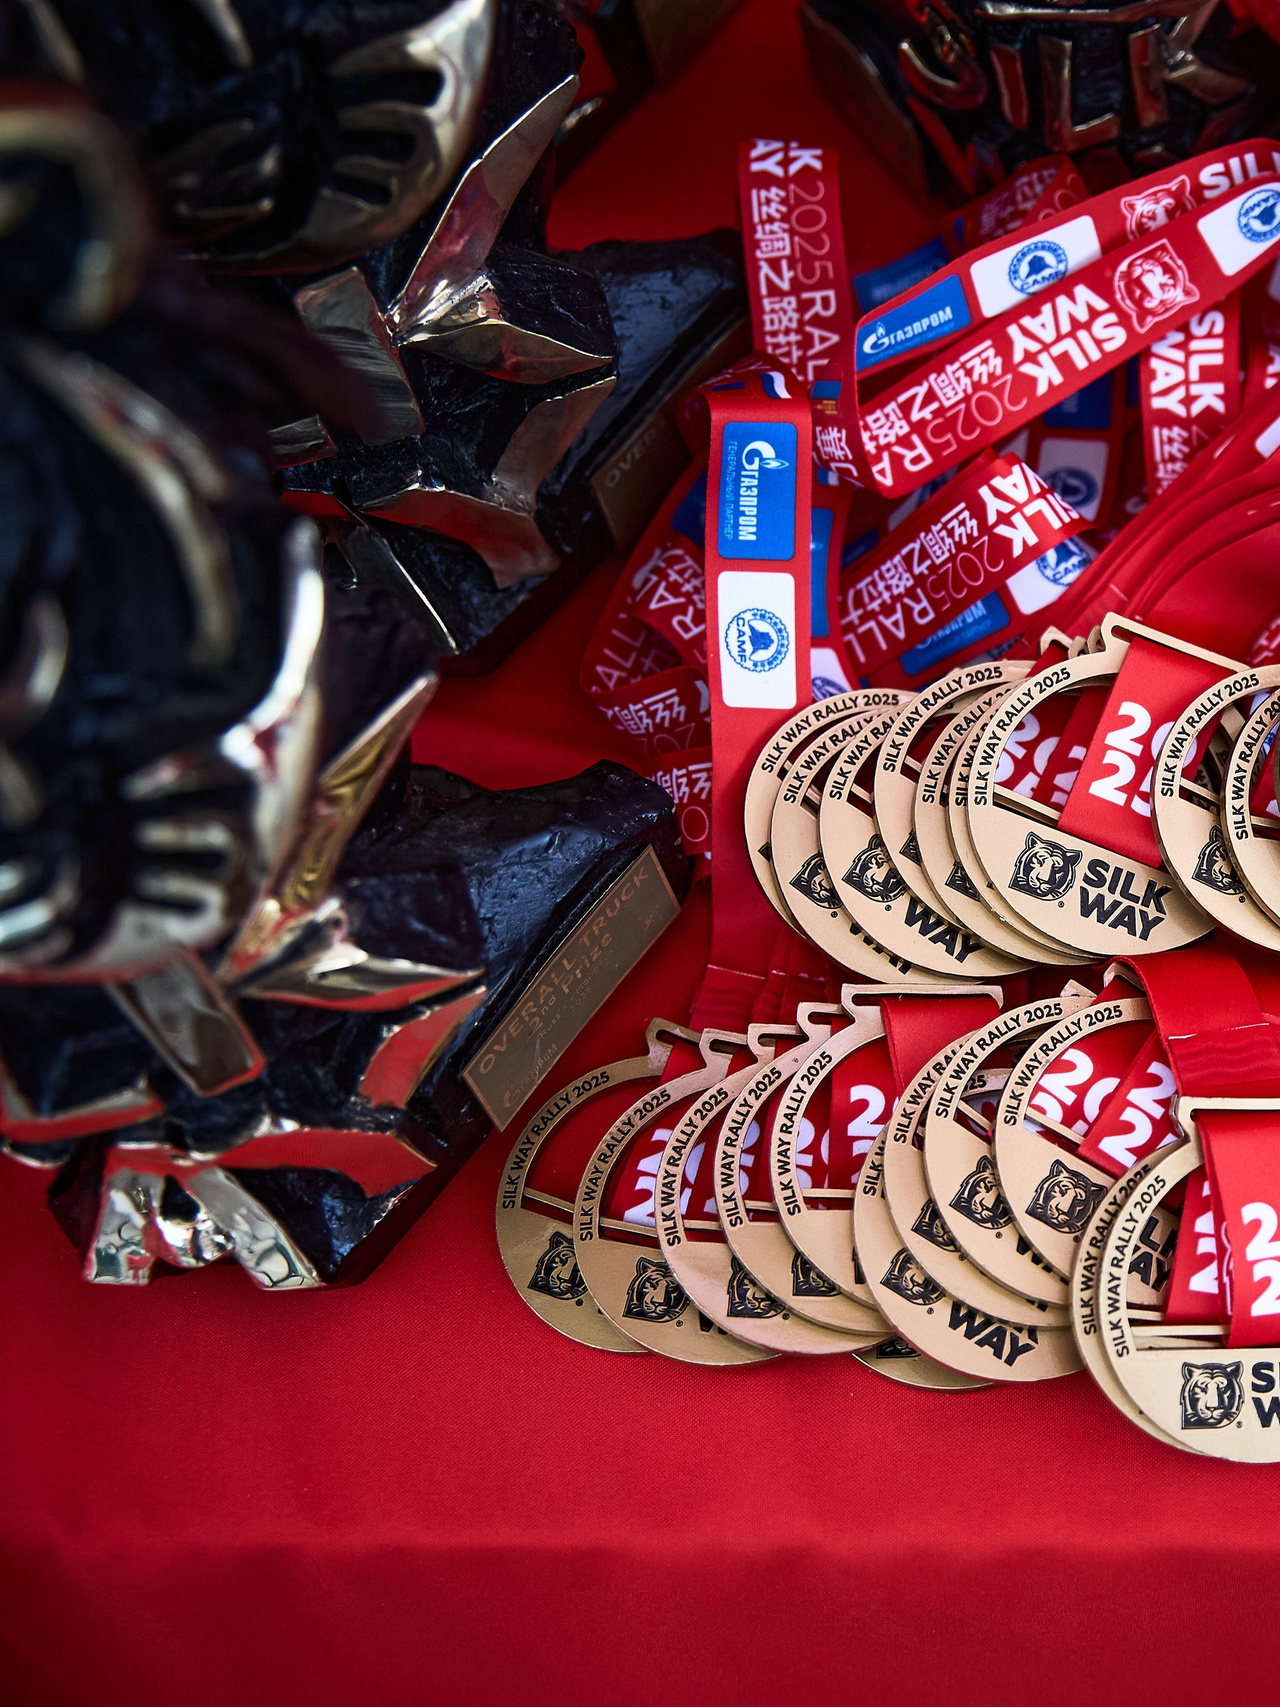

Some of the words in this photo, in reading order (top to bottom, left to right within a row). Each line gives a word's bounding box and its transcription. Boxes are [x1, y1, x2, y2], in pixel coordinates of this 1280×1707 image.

[788, 180, 834, 285] 2025
[889, 305, 952, 347] ГАЗПРОМ
[1007, 284, 1110, 366] WAY
[1019, 312, 1127, 397] SILK
[1150, 332, 1188, 418] WAY
[1189, 310, 1225, 416] SILK
[926, 374, 1027, 457] 2025
[738, 469, 758, 541] ГАЗПРОМ
[993, 492, 1081, 558] SILK
[927, 535, 1005, 613] 2025
[736, 616, 747, 664] CAMF
[920, 676, 964, 712] RALLY
[964, 666, 1003, 686] 2025
[1185, 690, 1224, 728] RALLY
[1223, 673, 1261, 699] 2025
[785, 718, 812, 745] WAY
[813, 698, 859, 723] RALLY
[863, 693, 900, 706] 2025
[980, 731, 1001, 768] WAY
[998, 685, 1036, 732] RALLY
[1033, 667, 1072, 693] 2025
[1104, 701, 1197, 772] 20
[1239, 716, 1266, 764] RALLY
[800, 744, 830, 772] WAY
[1167, 727, 1190, 764] WAY
[1160, 764, 1177, 798] SILK
[1230, 763, 1249, 803] WAY
[1235, 803, 1249, 841] SILK
[1082, 858, 1173, 915] SILK
[1079, 886, 1166, 942] WAY
[478, 955, 578, 1076] OVERALL
[577, 865, 651, 949] TRUCK
[747, 1065, 783, 1104] 2025
[801, 1050, 834, 1089] 2025
[935, 1083, 959, 1119] SILK
[949, 1046, 980, 1084] WAY
[975, 1014, 1022, 1051] RALLY
[1023, 1002, 1064, 1024] 2025
[1003, 1087, 1025, 1127] SILK
[1016, 1051, 1043, 1088] WAY
[1039, 1017, 1083, 1057] RALLY
[1084, 1004, 1124, 1027] 2025
[511, 1134, 536, 1175] WAY
[533, 1092, 572, 1137] RALLY
[570, 1070, 611, 1098] 2025
[633, 1088, 672, 1121] 2025
[694, 1086, 730, 1121] 2025
[725, 1098, 753, 1151] RALLY
[780, 1086, 808, 1138] RALLY
[893, 1103, 918, 1145] SILK
[907, 1071, 940, 1107] WAY
[599, 1115, 636, 1165] RALLY
[666, 1117, 699, 1166] RALLY
[777, 1137, 796, 1179] WAY
[581, 1164, 605, 1204] WAY
[660, 1165, 679, 1208] WAY
[720, 1150, 739, 1191] WAY
[724, 1190, 744, 1229] SILK
[780, 1178, 802, 1217] SILK
[1134, 1174, 1167, 1216] 2025
[580, 1203, 597, 1243] SILK
[660, 1207, 682, 1248] SILK
[1111, 1214, 1138, 1270] RALLY
[1080, 1251, 1100, 1297] WAY
[1108, 1273, 1124, 1319] WAY
[948, 1300, 1036, 1368] WAY
[1083, 1297, 1098, 1336] SILK
[1116, 1319, 1130, 1358] SILK
